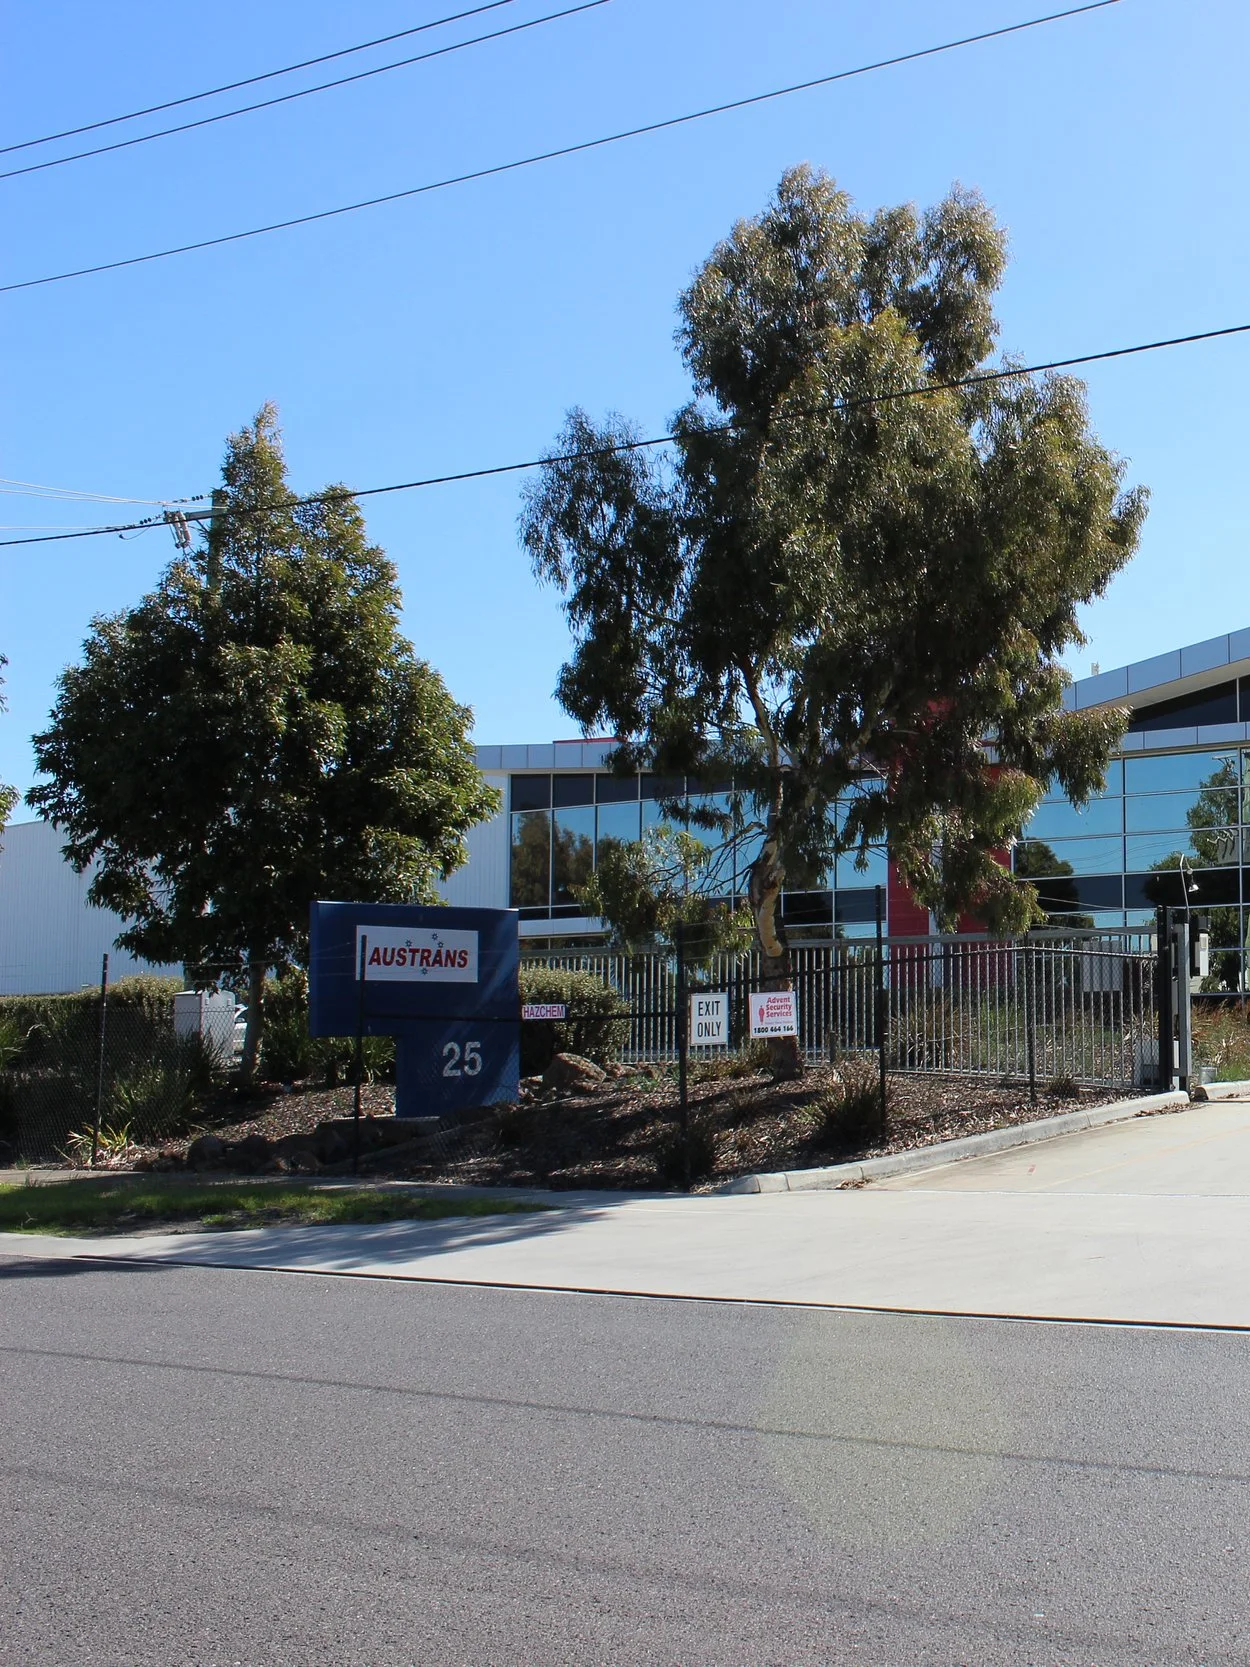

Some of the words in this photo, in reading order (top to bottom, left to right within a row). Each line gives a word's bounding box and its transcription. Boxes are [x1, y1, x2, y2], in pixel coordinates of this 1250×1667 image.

[368, 947, 468, 968] AUSTRANS
[523, 1005, 564, 1018] HAZCHEM
[698, 1001, 720, 1016] EXIT
[766, 1003, 792, 1011] Security
[766, 1010, 792, 1018] Services
[698, 1021, 721, 1037] ONLY
[442, 1041, 482, 1077] 25
